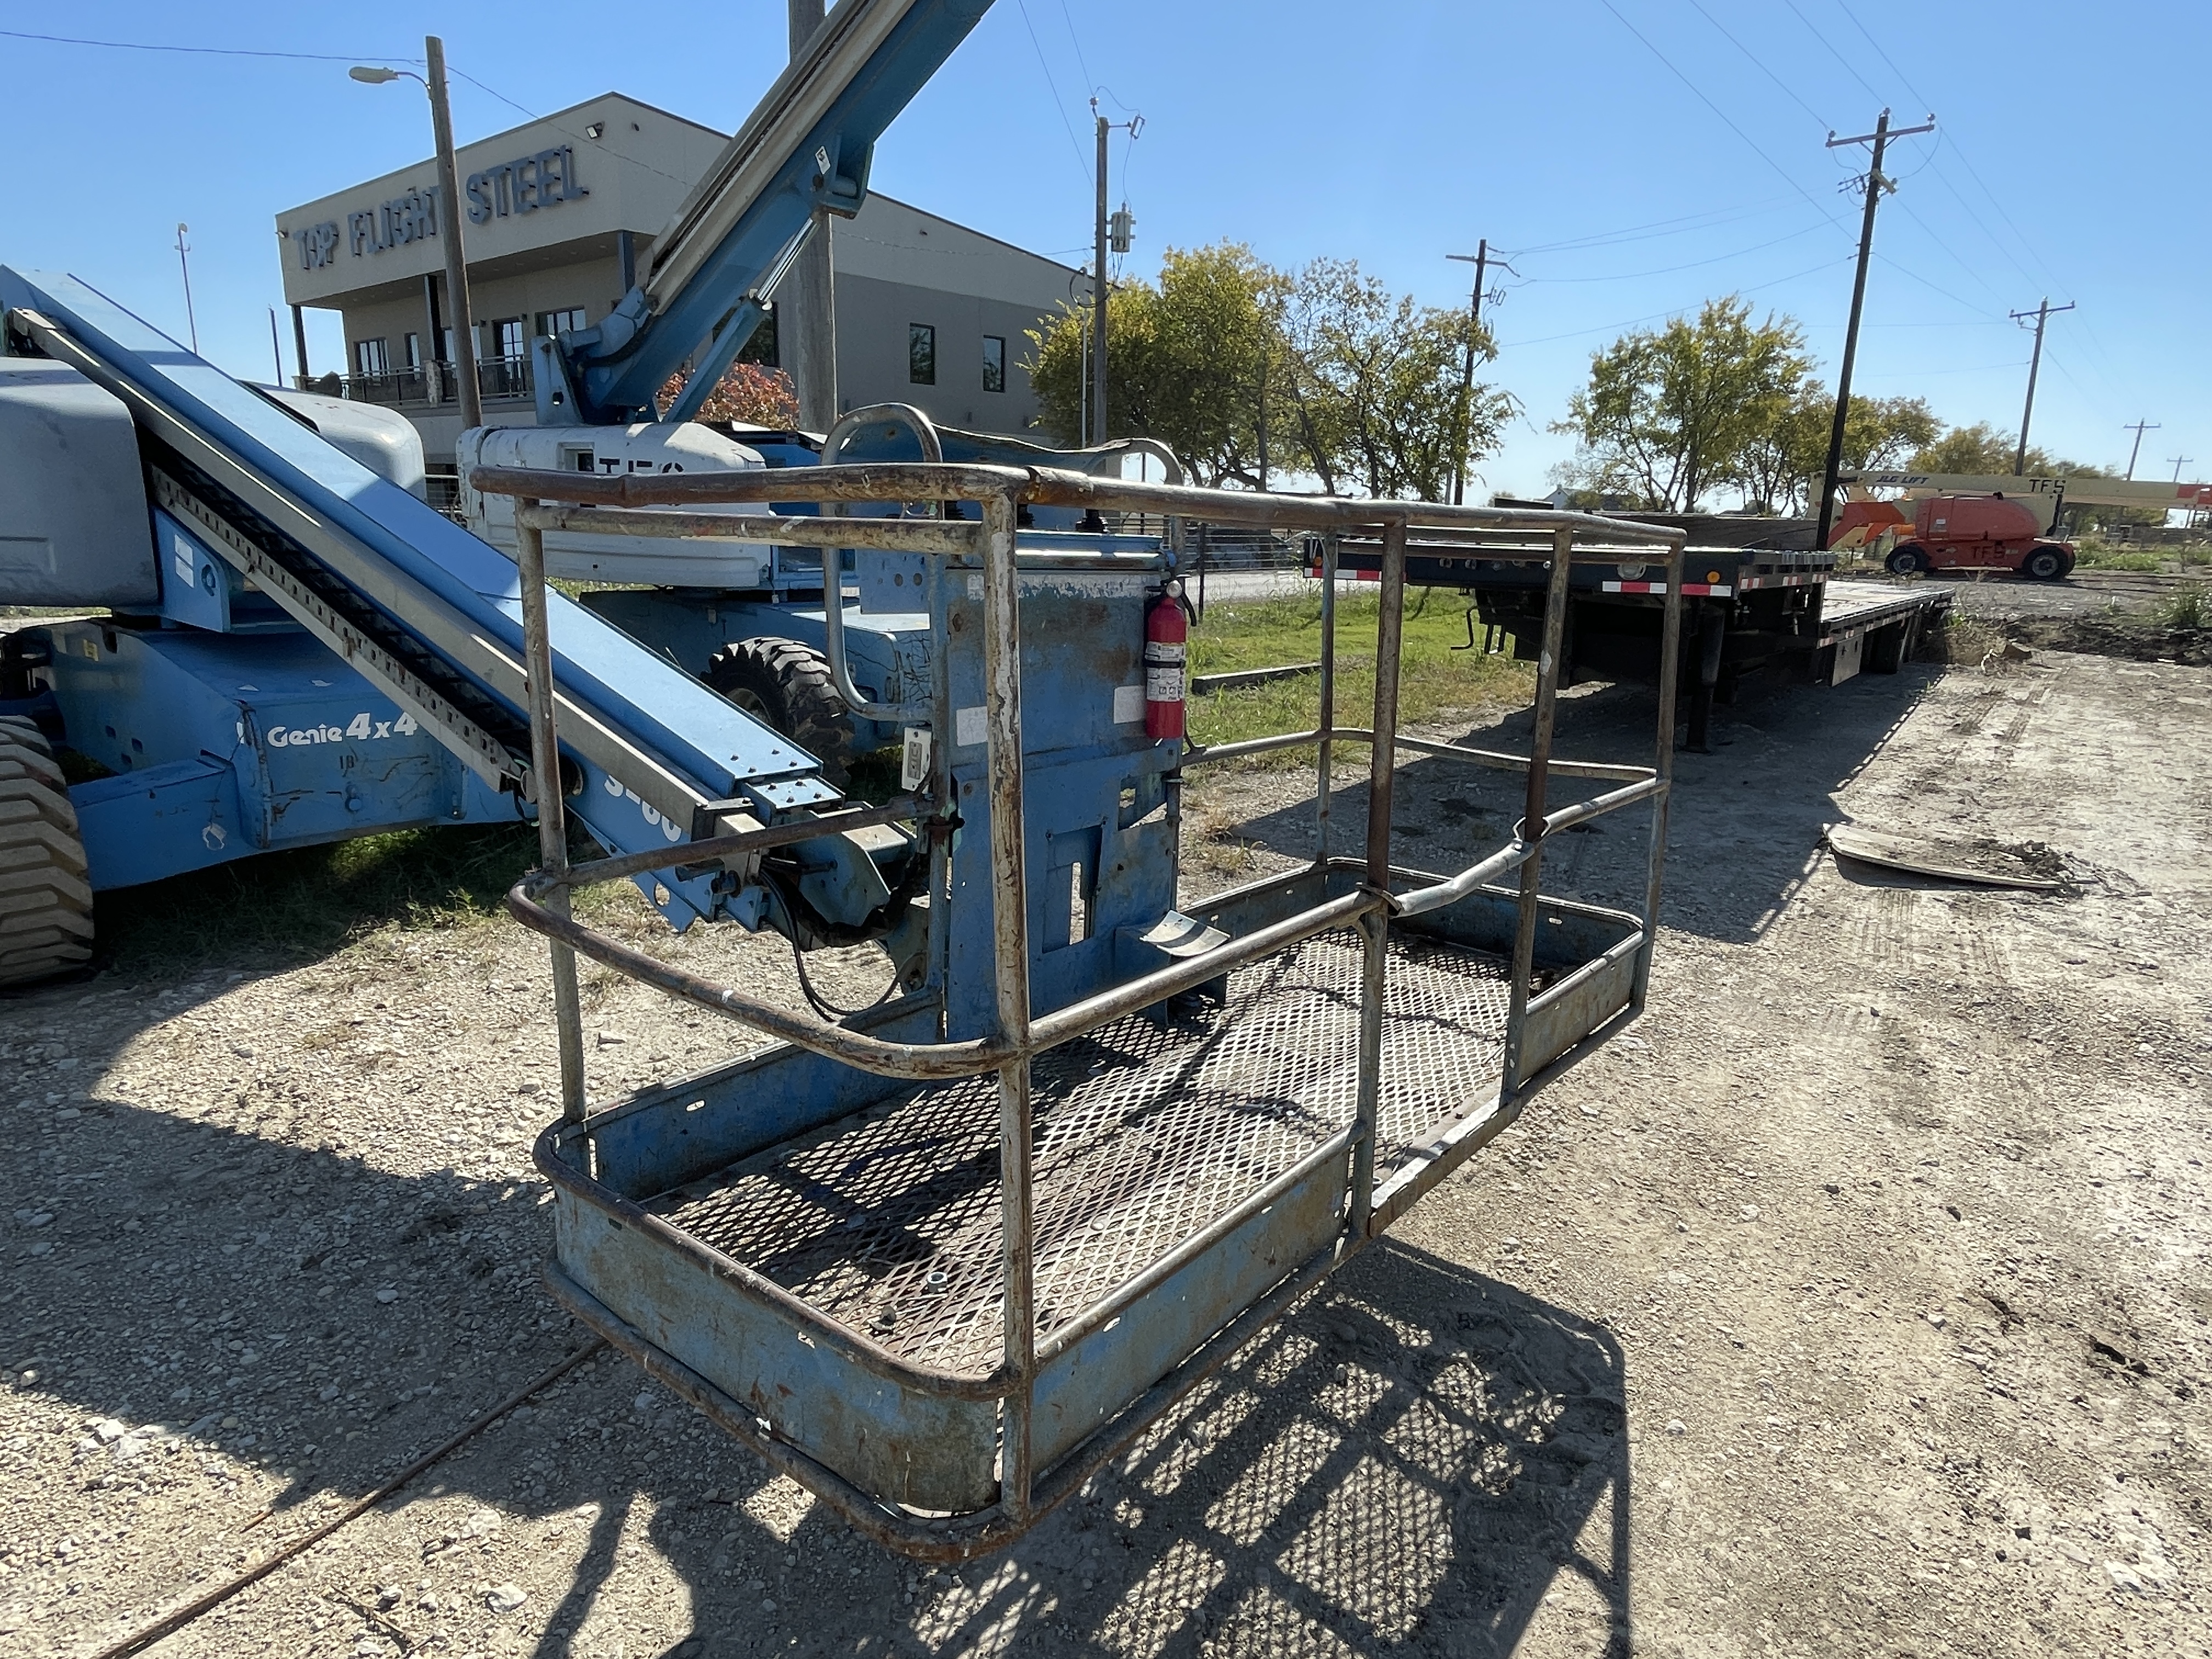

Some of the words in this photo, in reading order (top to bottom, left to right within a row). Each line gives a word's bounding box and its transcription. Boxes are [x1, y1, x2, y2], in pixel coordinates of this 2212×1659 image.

[293, 220, 338, 269] TOP
[466, 144, 589, 225] STEEL
[1900, 476, 1929, 484] LIFT
[2029, 478, 2066, 494] TFS
[267, 723, 343, 747] Genie
[346, 712, 418, 740] 4x4
